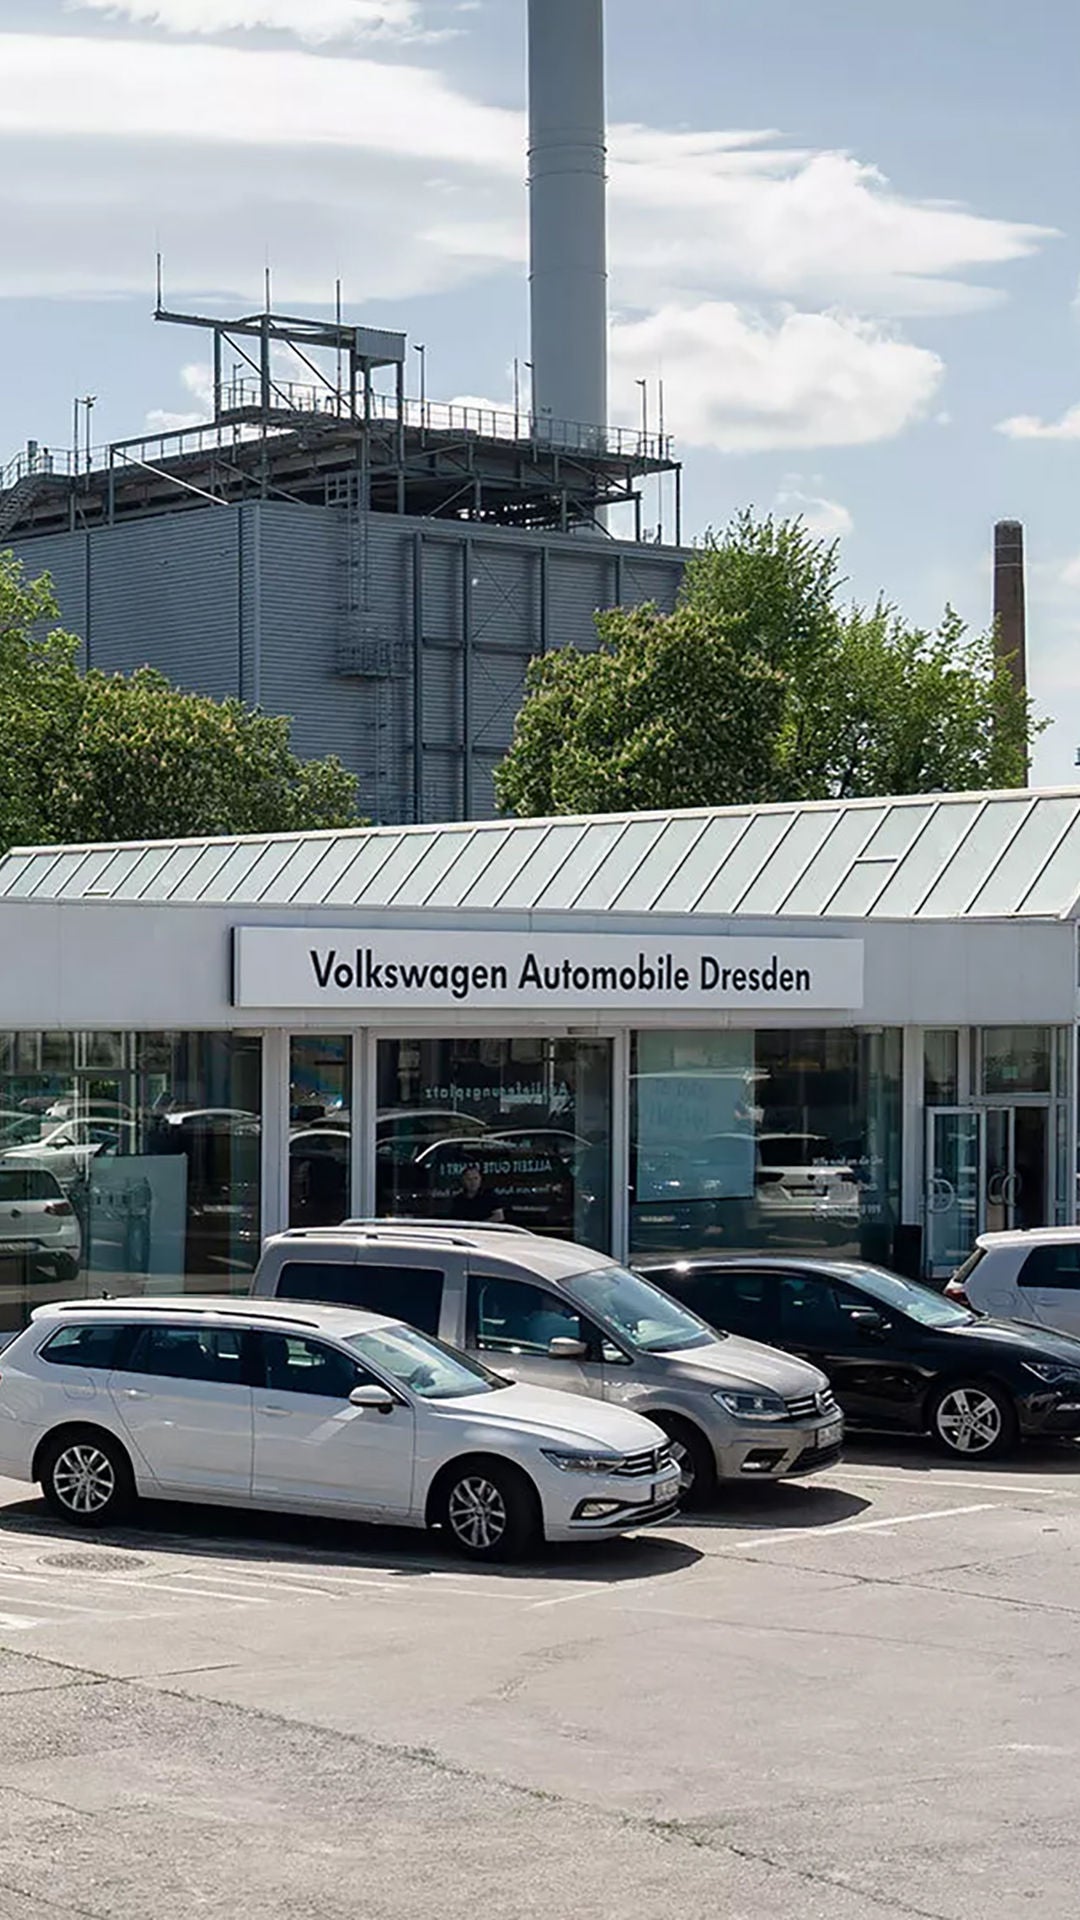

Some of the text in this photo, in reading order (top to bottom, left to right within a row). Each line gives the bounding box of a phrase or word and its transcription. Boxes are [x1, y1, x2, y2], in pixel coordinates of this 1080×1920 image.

[309, 948, 811, 999] Volkswagen Automobile Dresden
